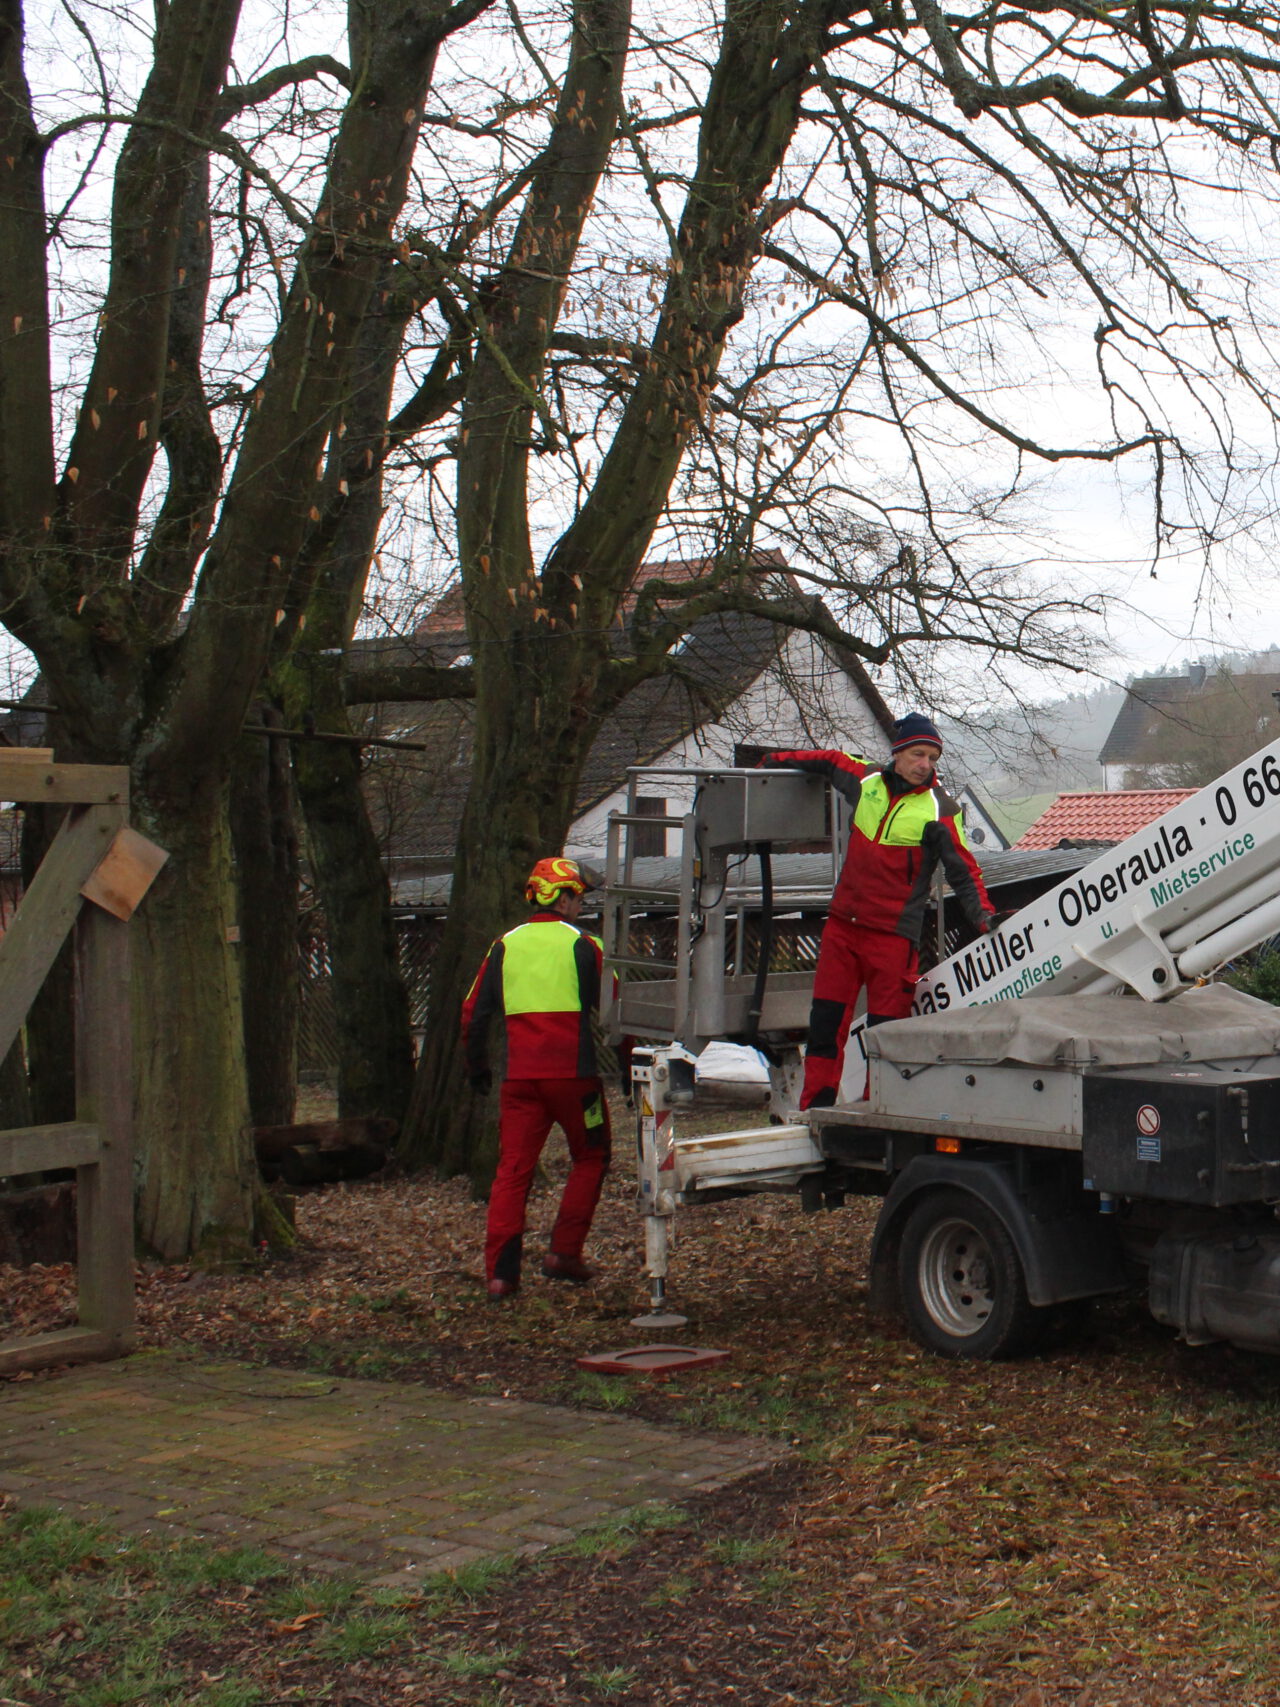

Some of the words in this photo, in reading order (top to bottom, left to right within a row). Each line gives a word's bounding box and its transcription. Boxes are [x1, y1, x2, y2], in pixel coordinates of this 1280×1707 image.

[952, 922, 1035, 998] Müller
[1058, 825, 1194, 927] Oberaula
[1215, 786, 1238, 827] 0
[1100, 921, 1119, 940] u.
[1150, 832, 1256, 909] Mietservice
